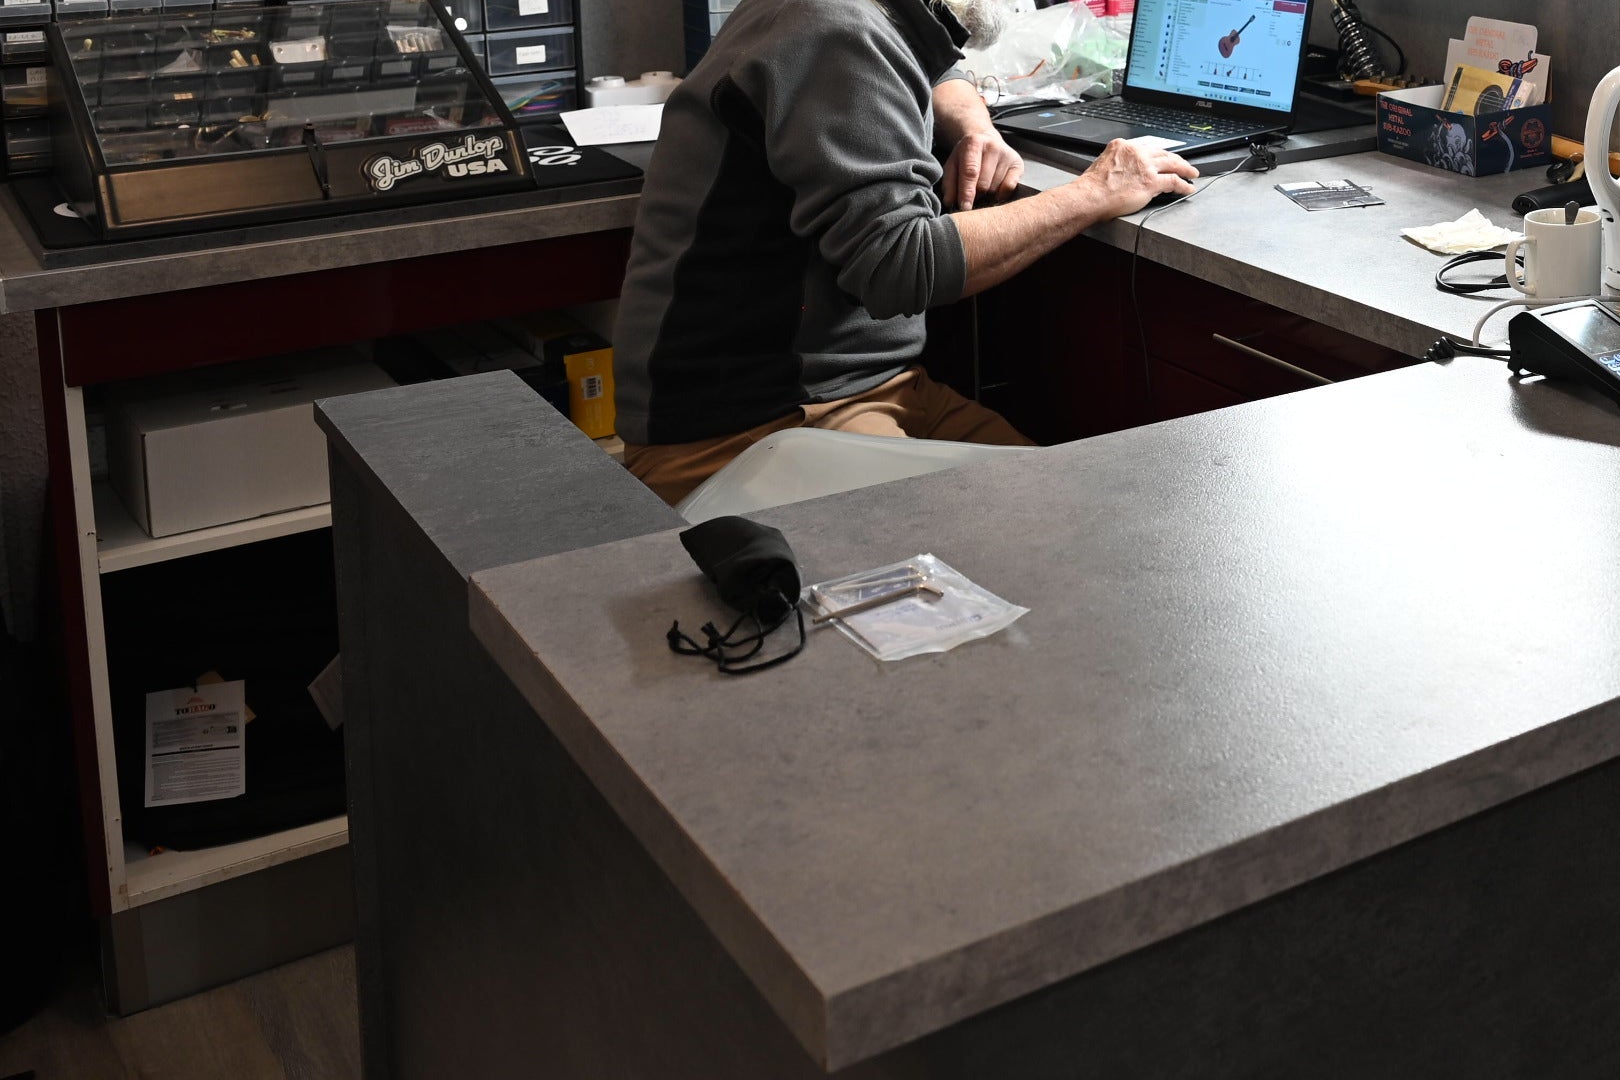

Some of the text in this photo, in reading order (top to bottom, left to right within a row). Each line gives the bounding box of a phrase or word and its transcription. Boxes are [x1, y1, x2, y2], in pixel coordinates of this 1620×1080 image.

[1195, 101, 1213, 109] ASUS
[1389, 103, 1413, 117] ORIGINAL
[1388, 114, 1404, 125] METAL
[369, 156, 421, 192] Jim
[419, 136, 503, 170] Dunlop
[448, 158, 509, 177] USA
